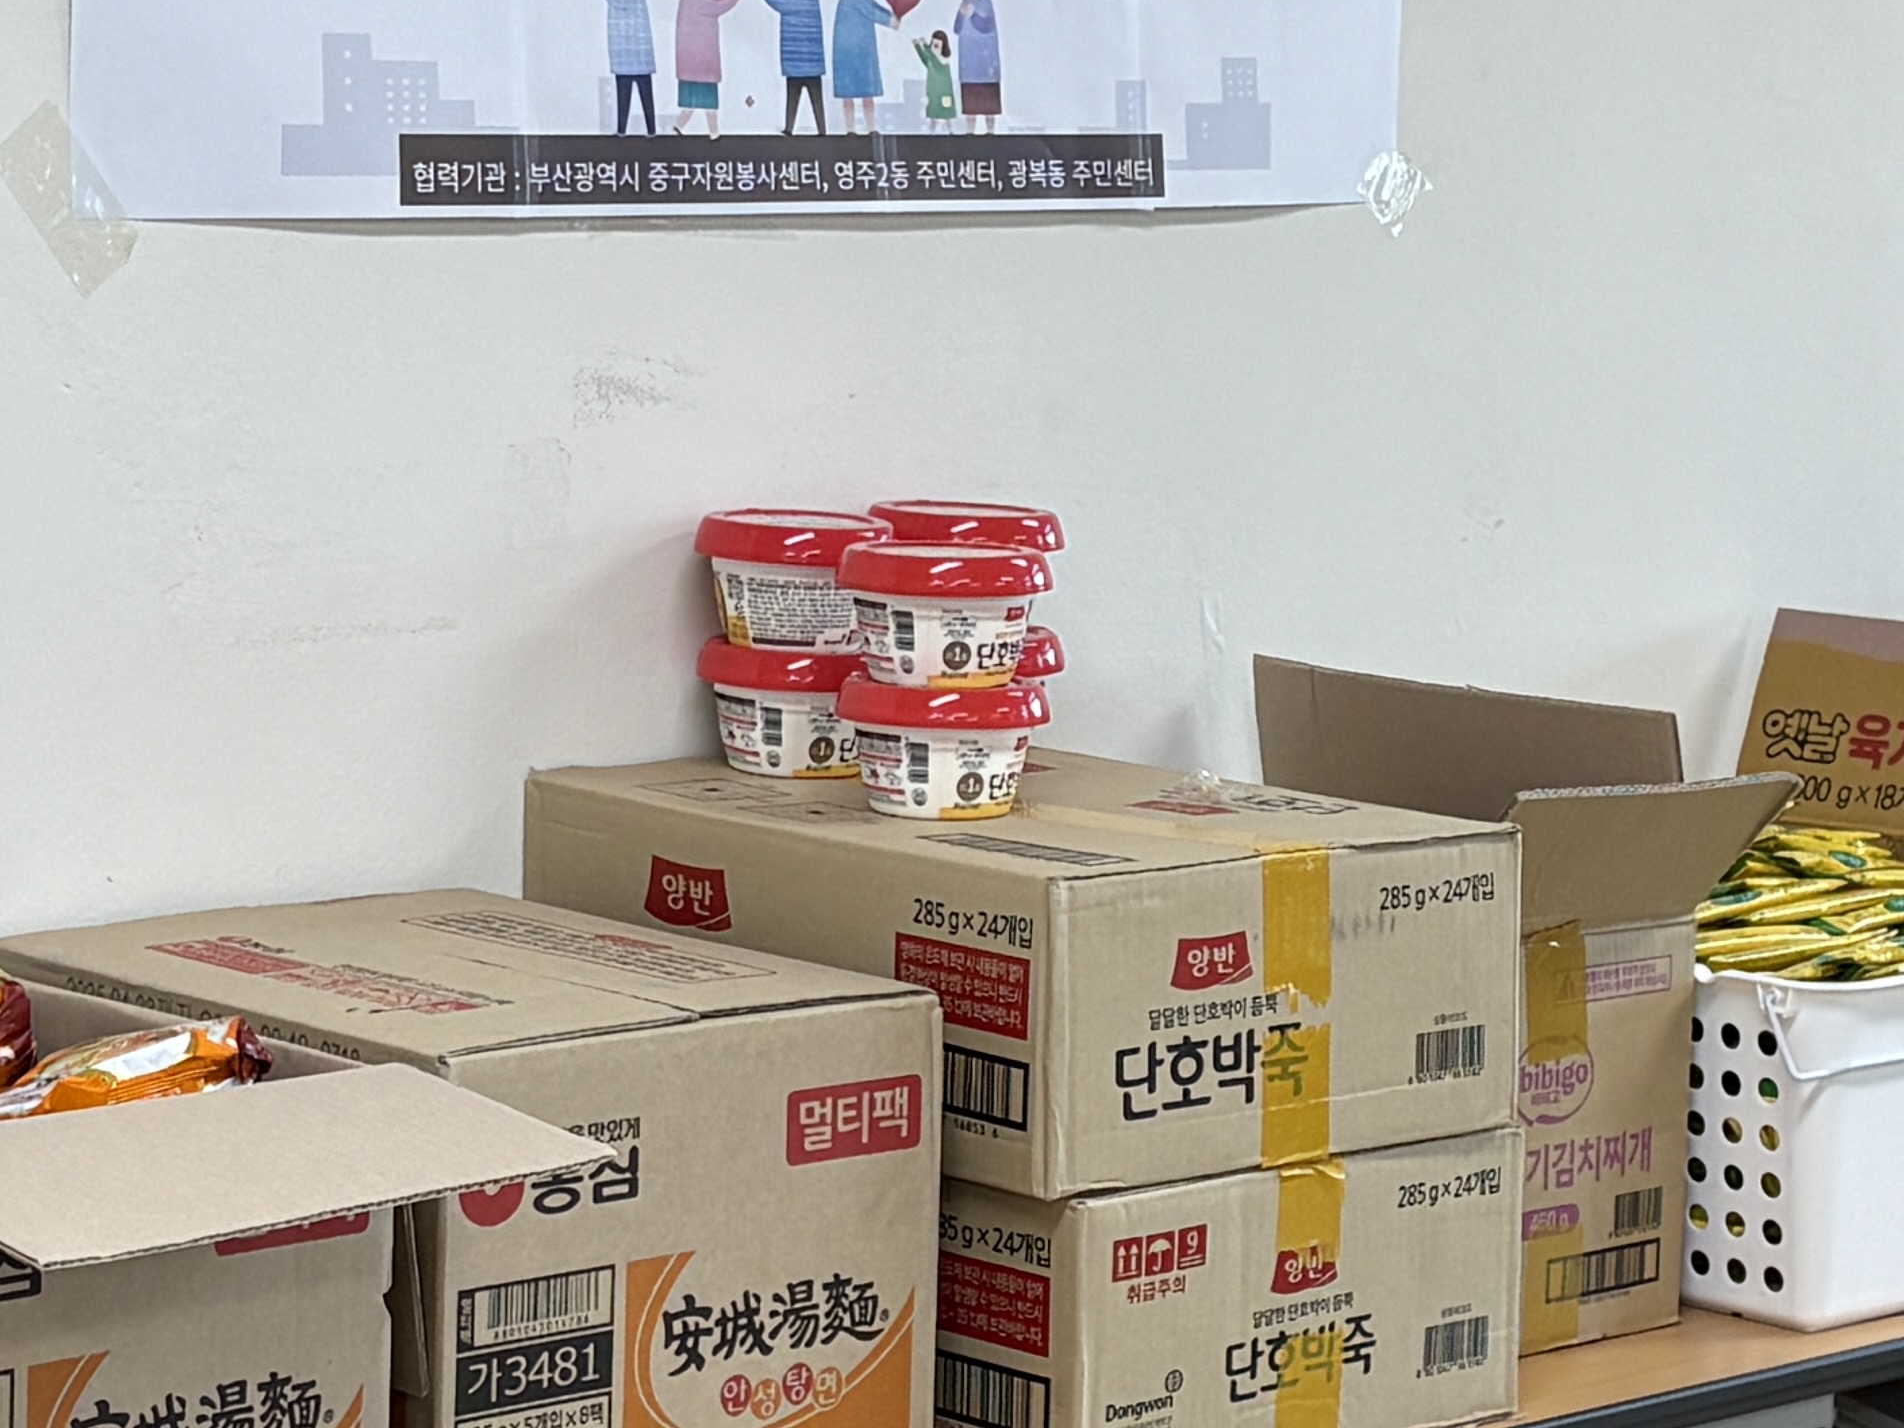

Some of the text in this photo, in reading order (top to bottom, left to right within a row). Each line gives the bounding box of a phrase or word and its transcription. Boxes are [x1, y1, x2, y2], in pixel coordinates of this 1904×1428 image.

[412, 157, 1155, 194] 협력기관 부산광역시 중구자원봉사센터, 영주2동 주민센터, 광복동 주민센터
[1762, 708, 1851, 766] 옛날
[660, 871, 714, 918] 양반
[1187, 943, 1236, 978] 양반
[1147, 999, 1248, 1031] 달달한 단호박이
[1114, 1021, 1309, 1122] 단호박죽
[1518, 1061, 1589, 1098] bibigo
[798, 1085, 910, 1153] 멀티팩
[1126, 1274, 1187, 1305] 취급주의
[466, 1341, 601, 1403] 가3481
[1224, 1312, 1377, 1404] 단호박죽
[720, 1361, 844, 1416] 안성탕면
[1104, 1393, 1174, 1424] Dongwon
